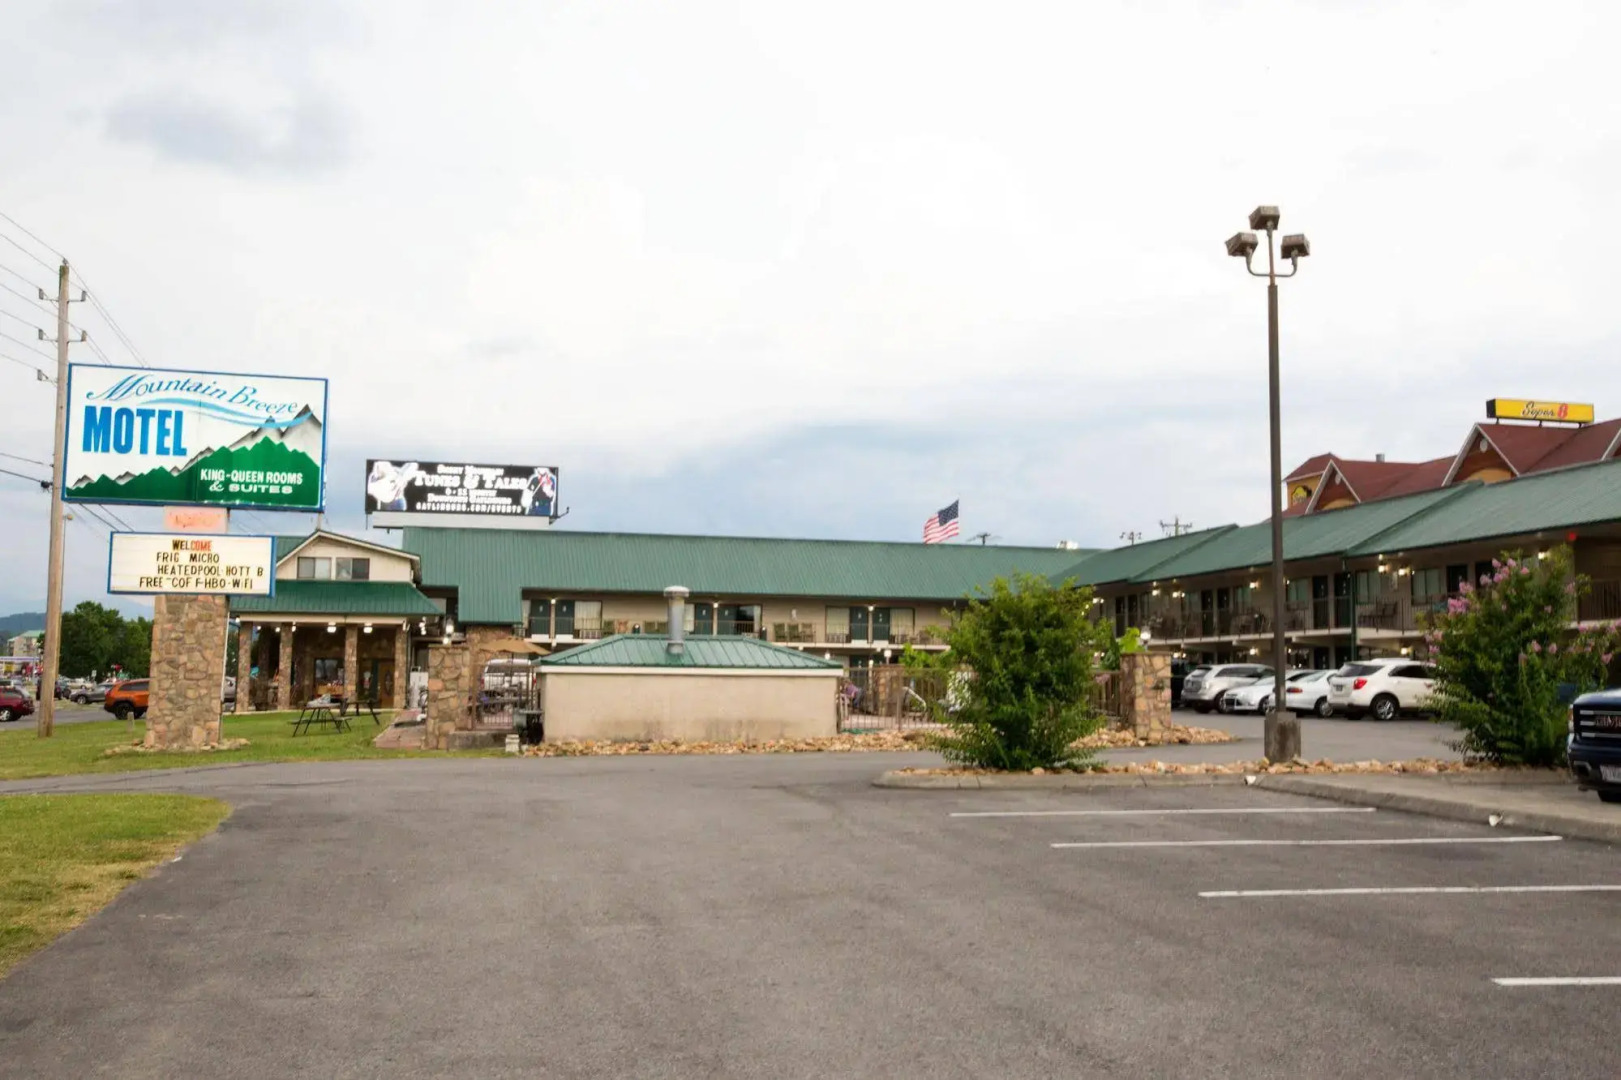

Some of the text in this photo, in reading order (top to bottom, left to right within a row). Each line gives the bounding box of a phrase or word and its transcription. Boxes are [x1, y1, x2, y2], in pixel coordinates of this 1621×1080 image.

[86, 373, 298, 414] Mountain Breeze
[1557, 403, 1568, 419] 8
[82, 405, 187, 456] MOTEL
[266, 471, 303, 485] ROOMS
[209, 480, 293, 495] & SUITES
[172, 540, 212, 551] WELCOME
[156, 552, 220, 563] FRIG MICRO
[139, 577, 163, 588] FREE
